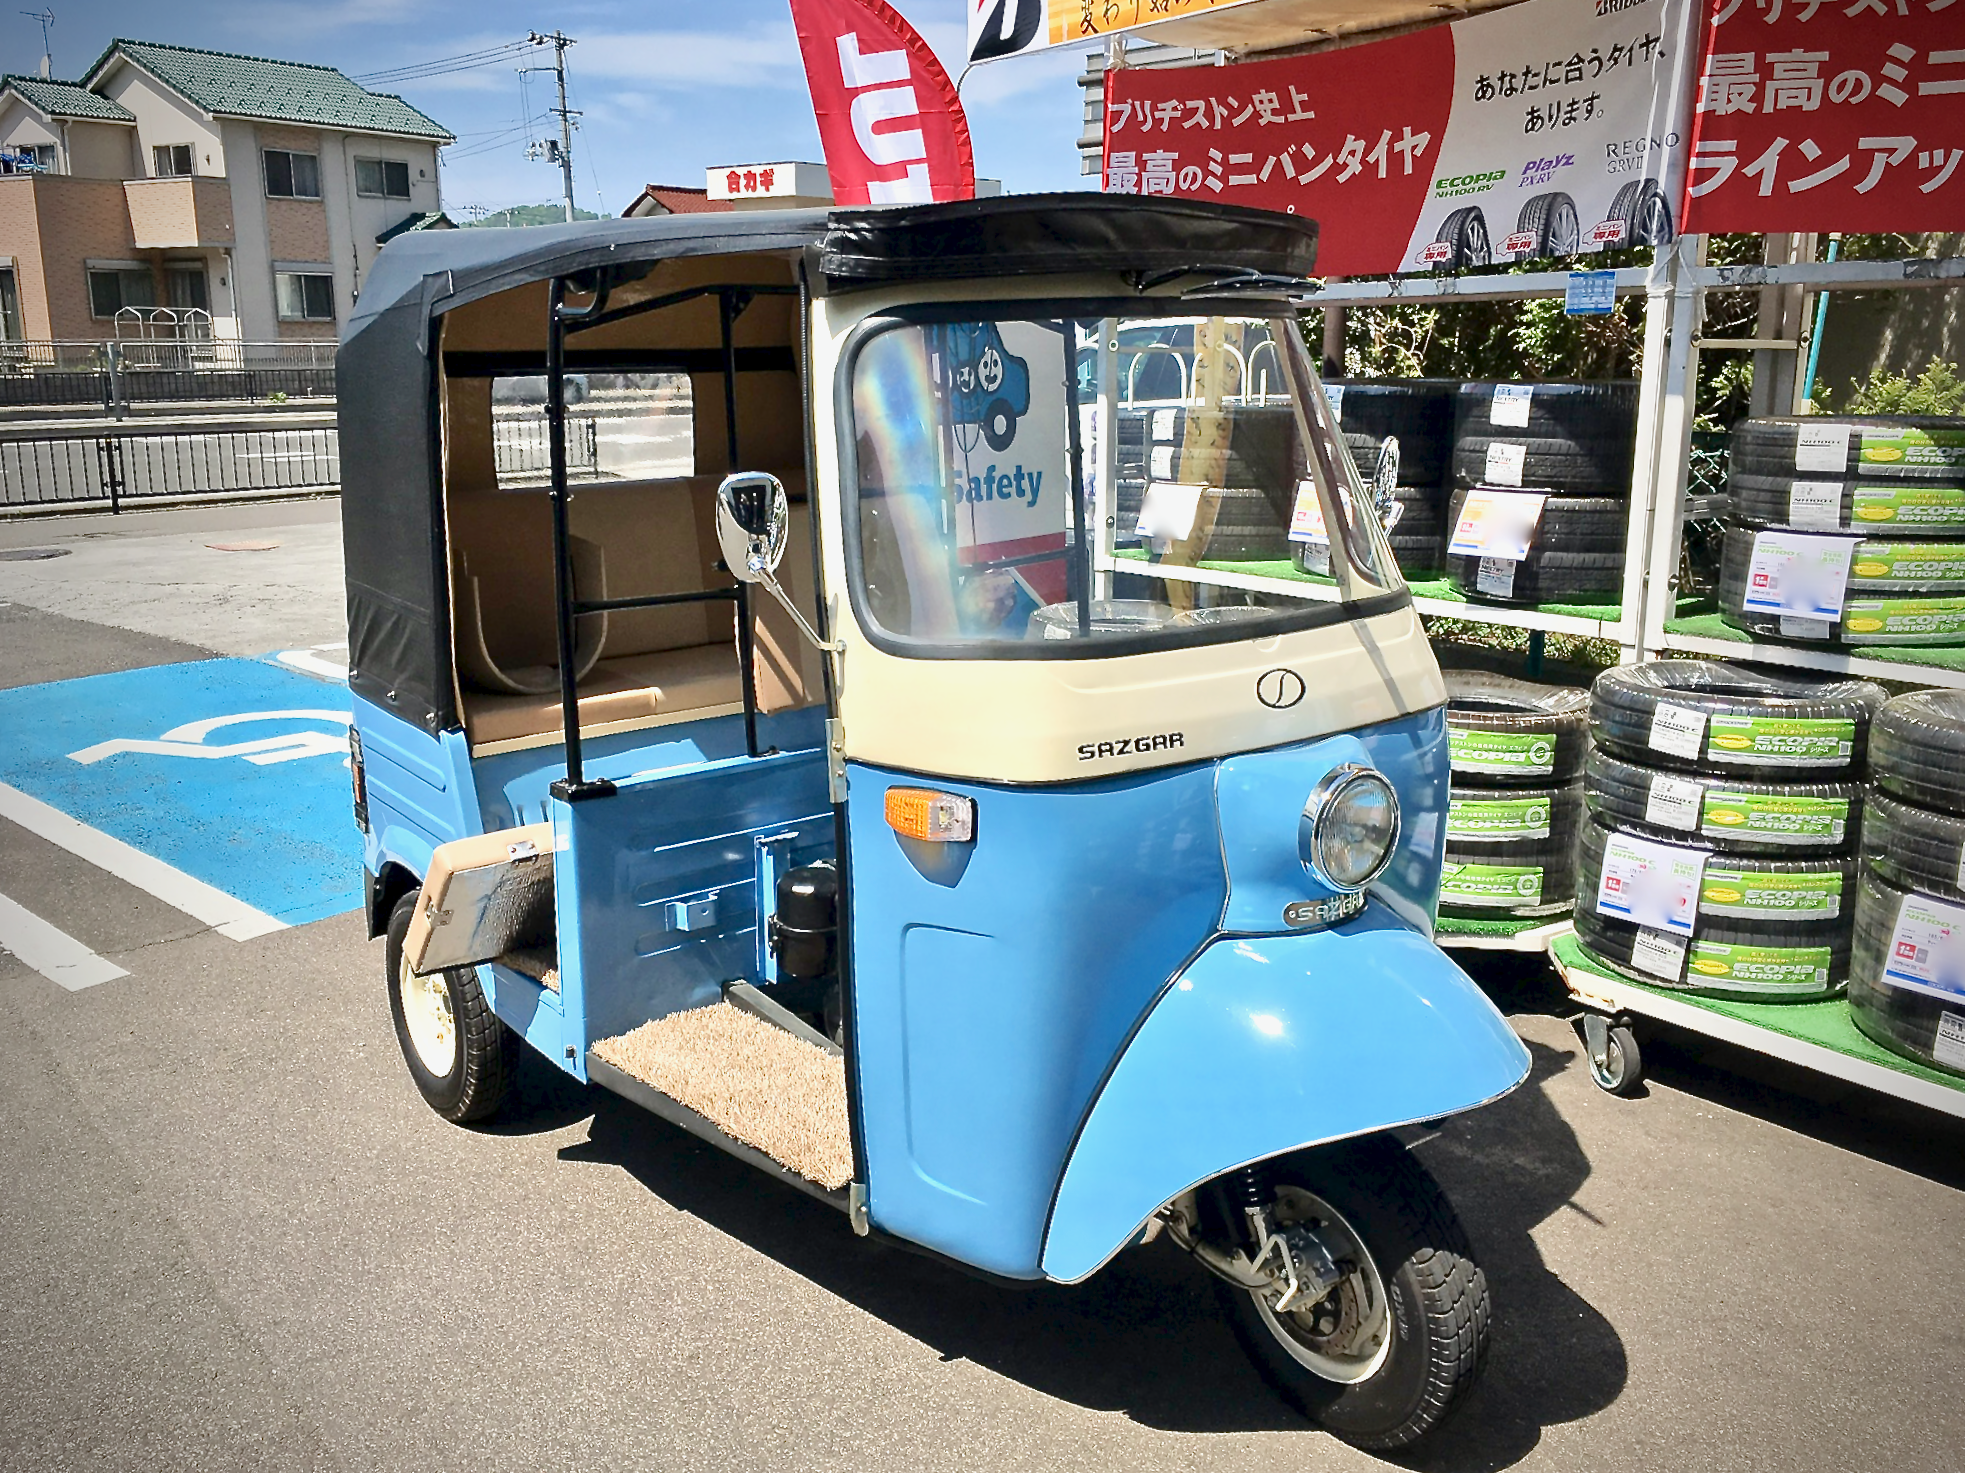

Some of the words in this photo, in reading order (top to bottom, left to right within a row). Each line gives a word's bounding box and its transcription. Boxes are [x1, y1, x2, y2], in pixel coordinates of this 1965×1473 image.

[1524, 91, 1606, 135] あります。
[1078, 731, 1185, 761] SAZGAR
